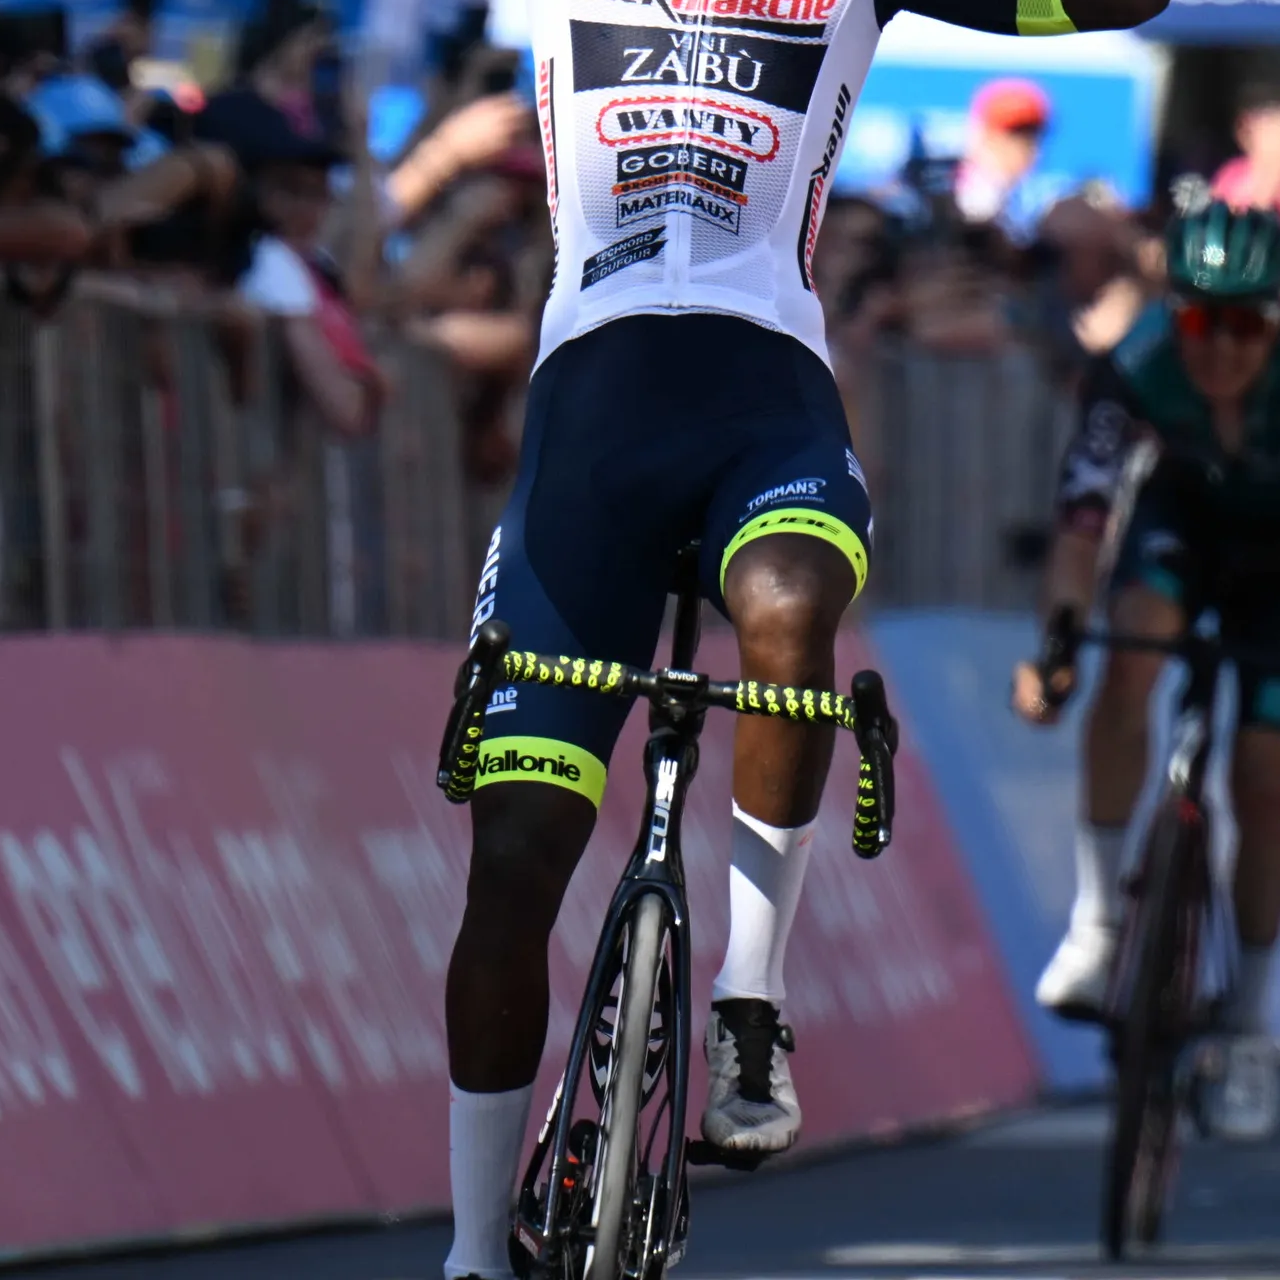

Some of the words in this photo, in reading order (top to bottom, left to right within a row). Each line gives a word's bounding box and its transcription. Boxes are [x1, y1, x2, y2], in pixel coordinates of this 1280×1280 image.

[668, 33, 728, 54] VINI
[621, 48, 765, 93] ZABÙ
[616, 108, 761, 147] WANTY
[622, 150, 742, 183] GOBERT
[595, 233, 653, 263] TECHNORD
[600, 248, 652, 278] DUFOUR
[747, 481, 818, 510] TORMANS
[645, 757, 678, 865] CUBE
